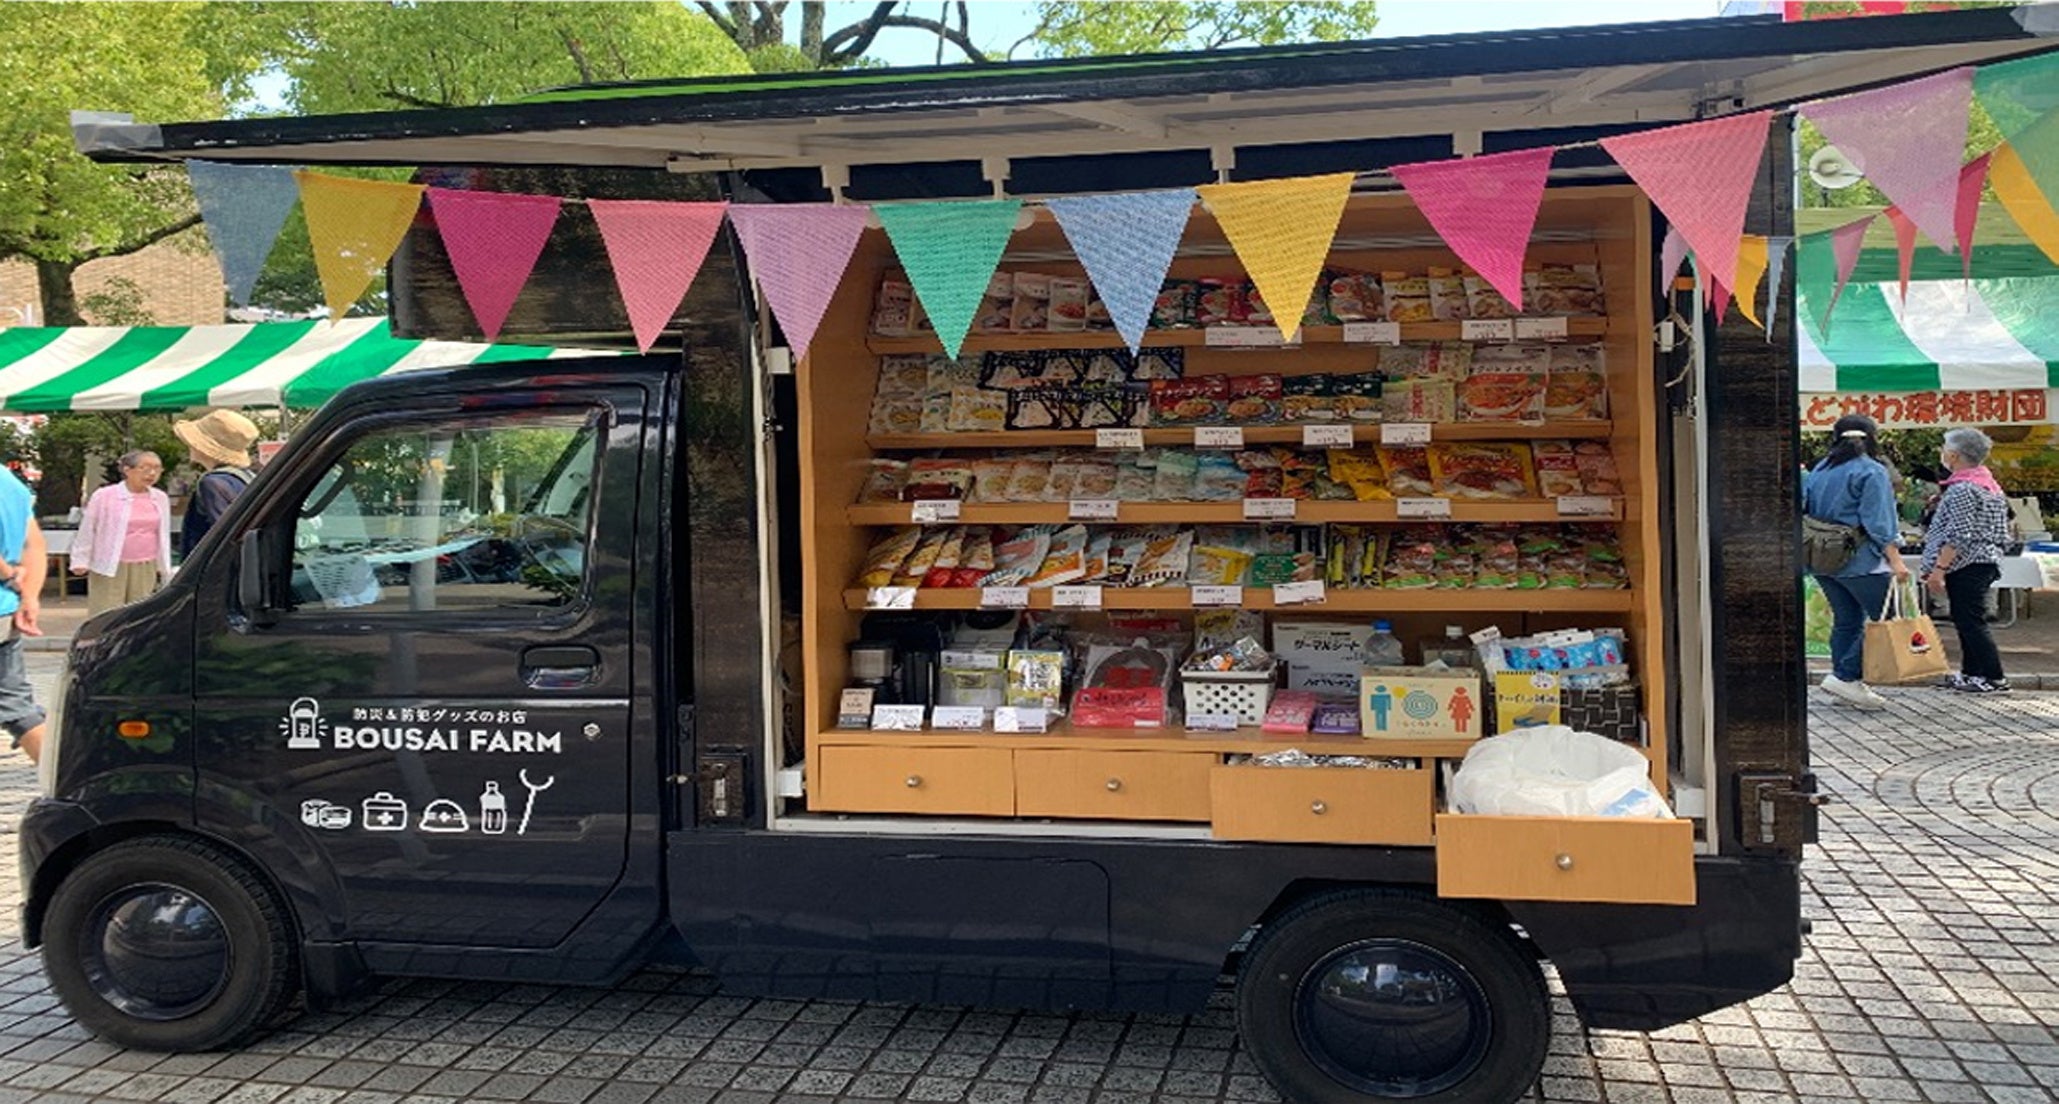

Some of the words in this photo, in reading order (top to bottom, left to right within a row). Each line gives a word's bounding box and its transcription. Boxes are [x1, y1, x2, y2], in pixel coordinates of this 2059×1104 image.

[1800, 389, 2046, 425] どがわ環境財団
[334, 726, 459, 751] BOUSAI
[469, 728, 562, 754] FARM
